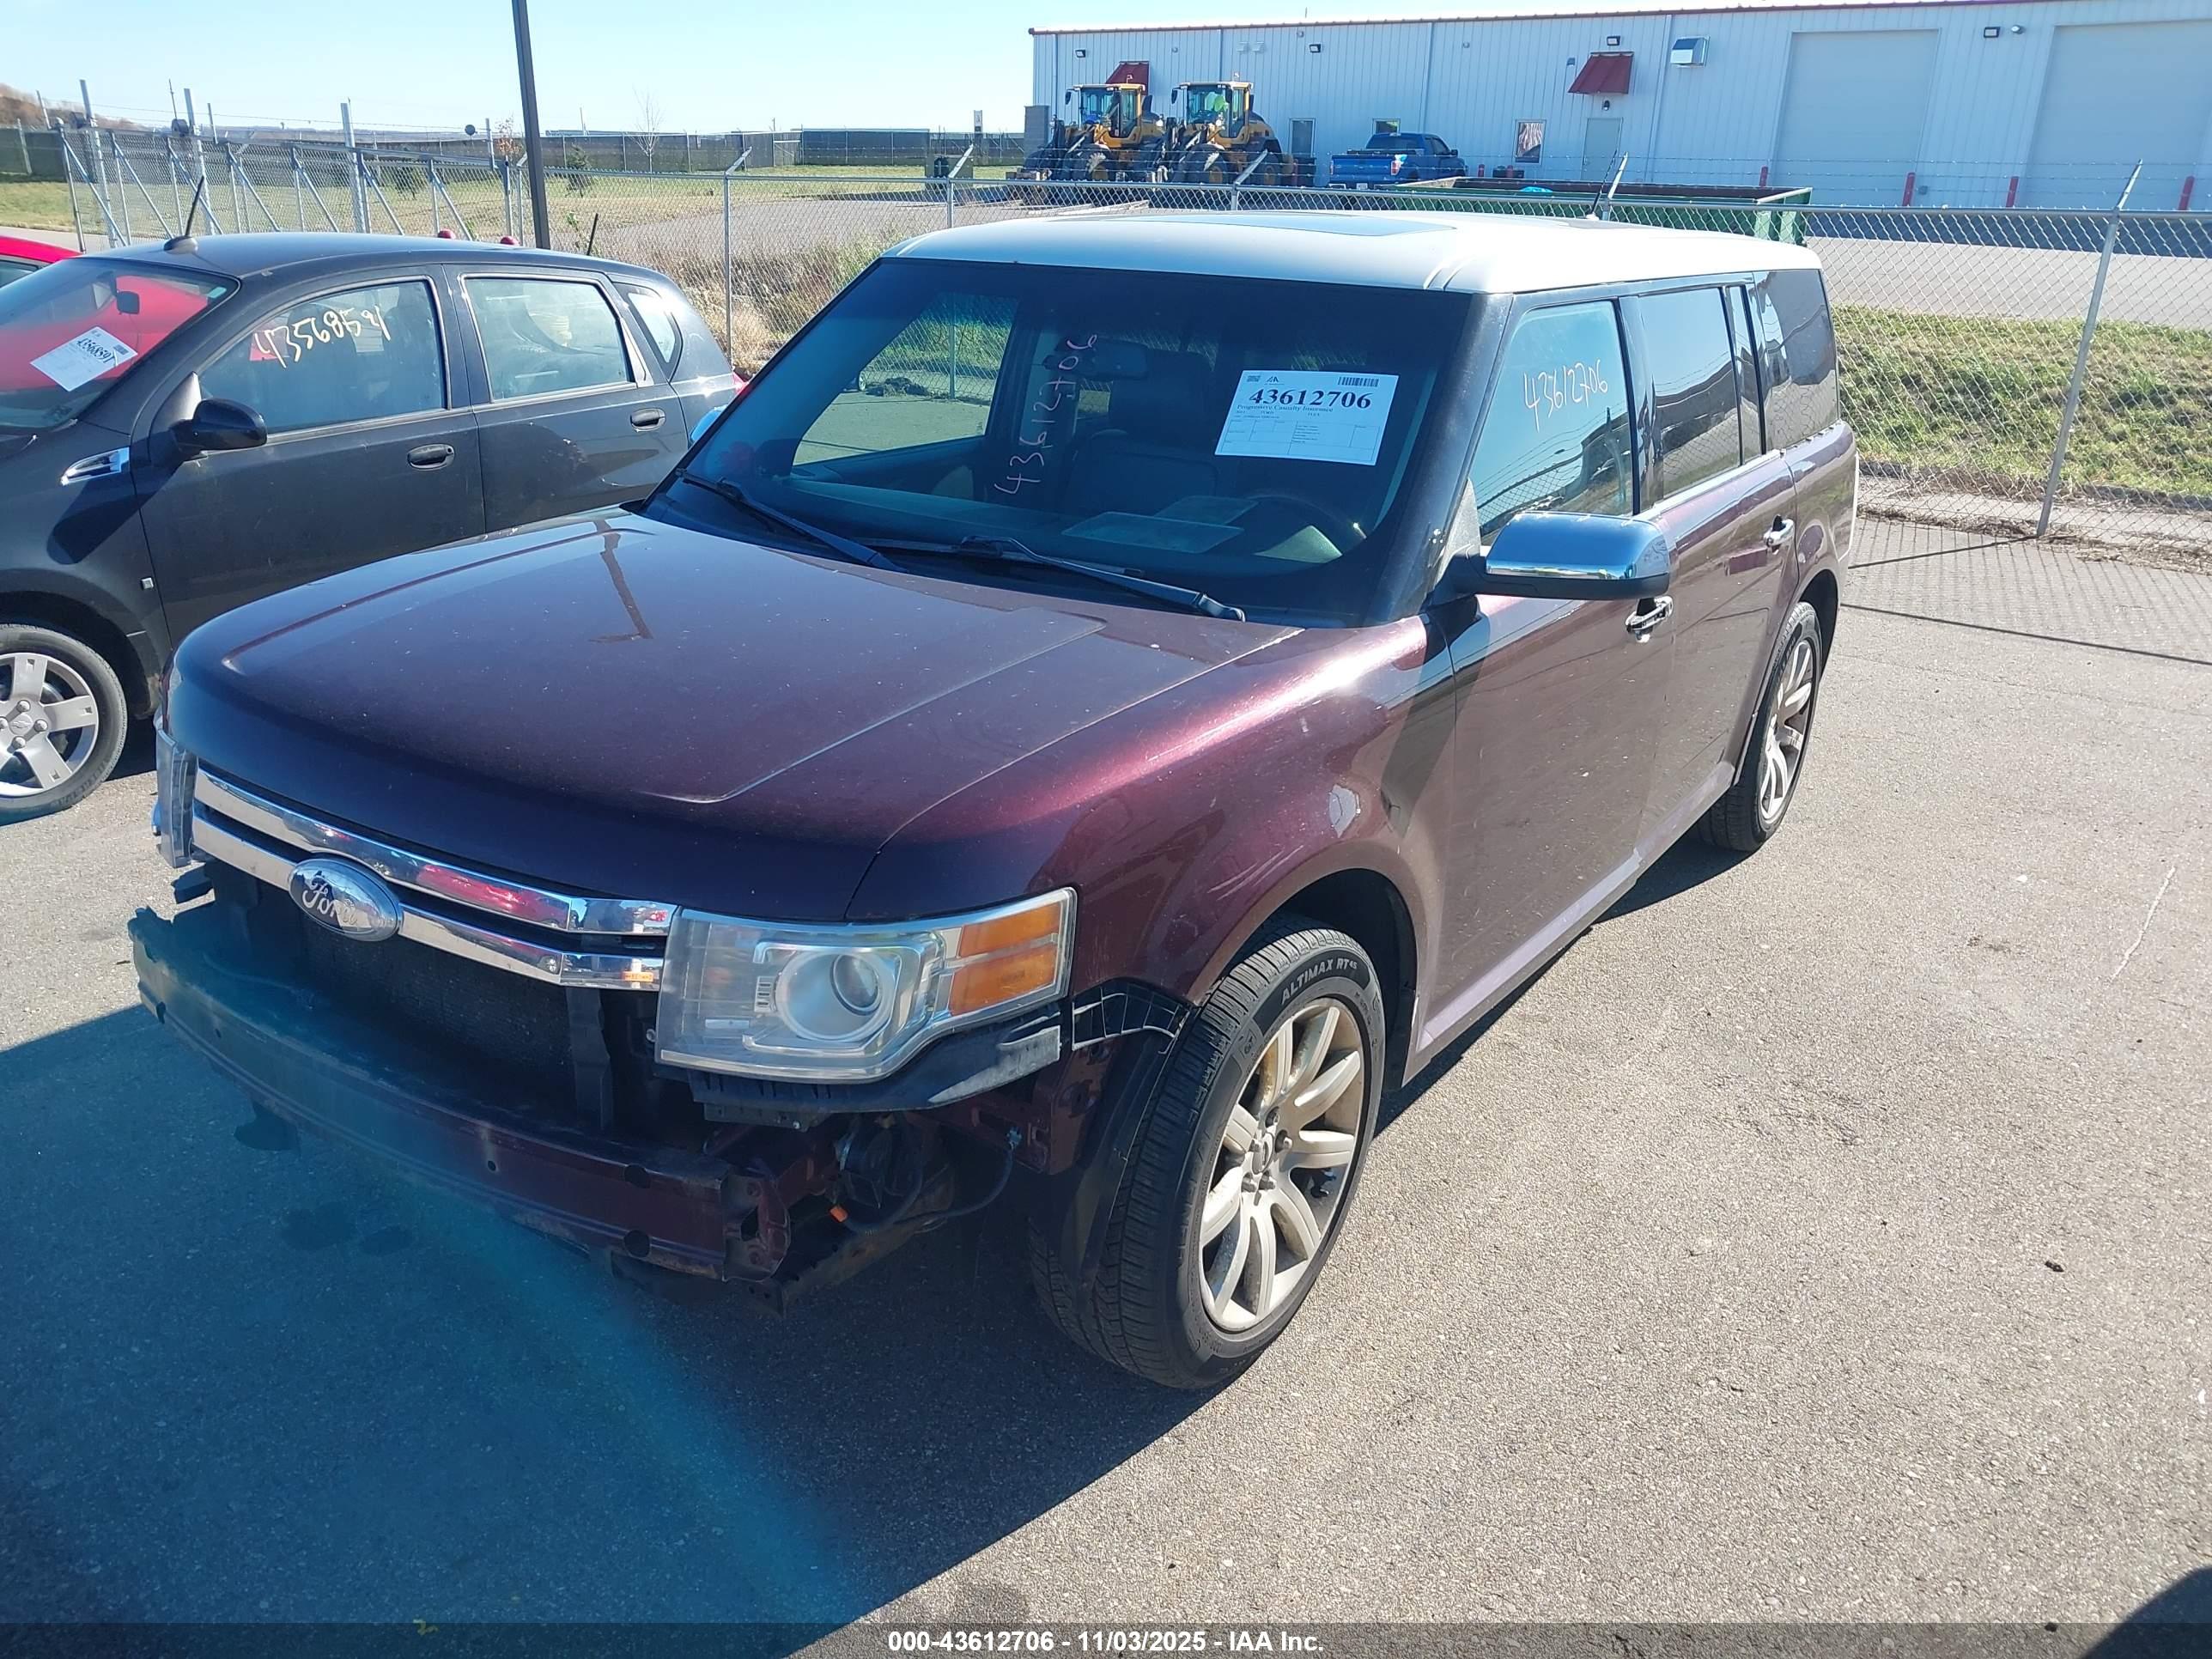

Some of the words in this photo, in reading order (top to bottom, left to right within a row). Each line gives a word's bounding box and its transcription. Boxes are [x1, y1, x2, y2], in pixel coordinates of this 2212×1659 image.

[994, 334, 1097, 495] 43612706
[1249, 389, 1374, 409] 43612706
[1523, 359, 1608, 434] 43612706
[301, 875, 358, 926] Ford
[1280, 958, 1334, 1006] ALTIMAX
